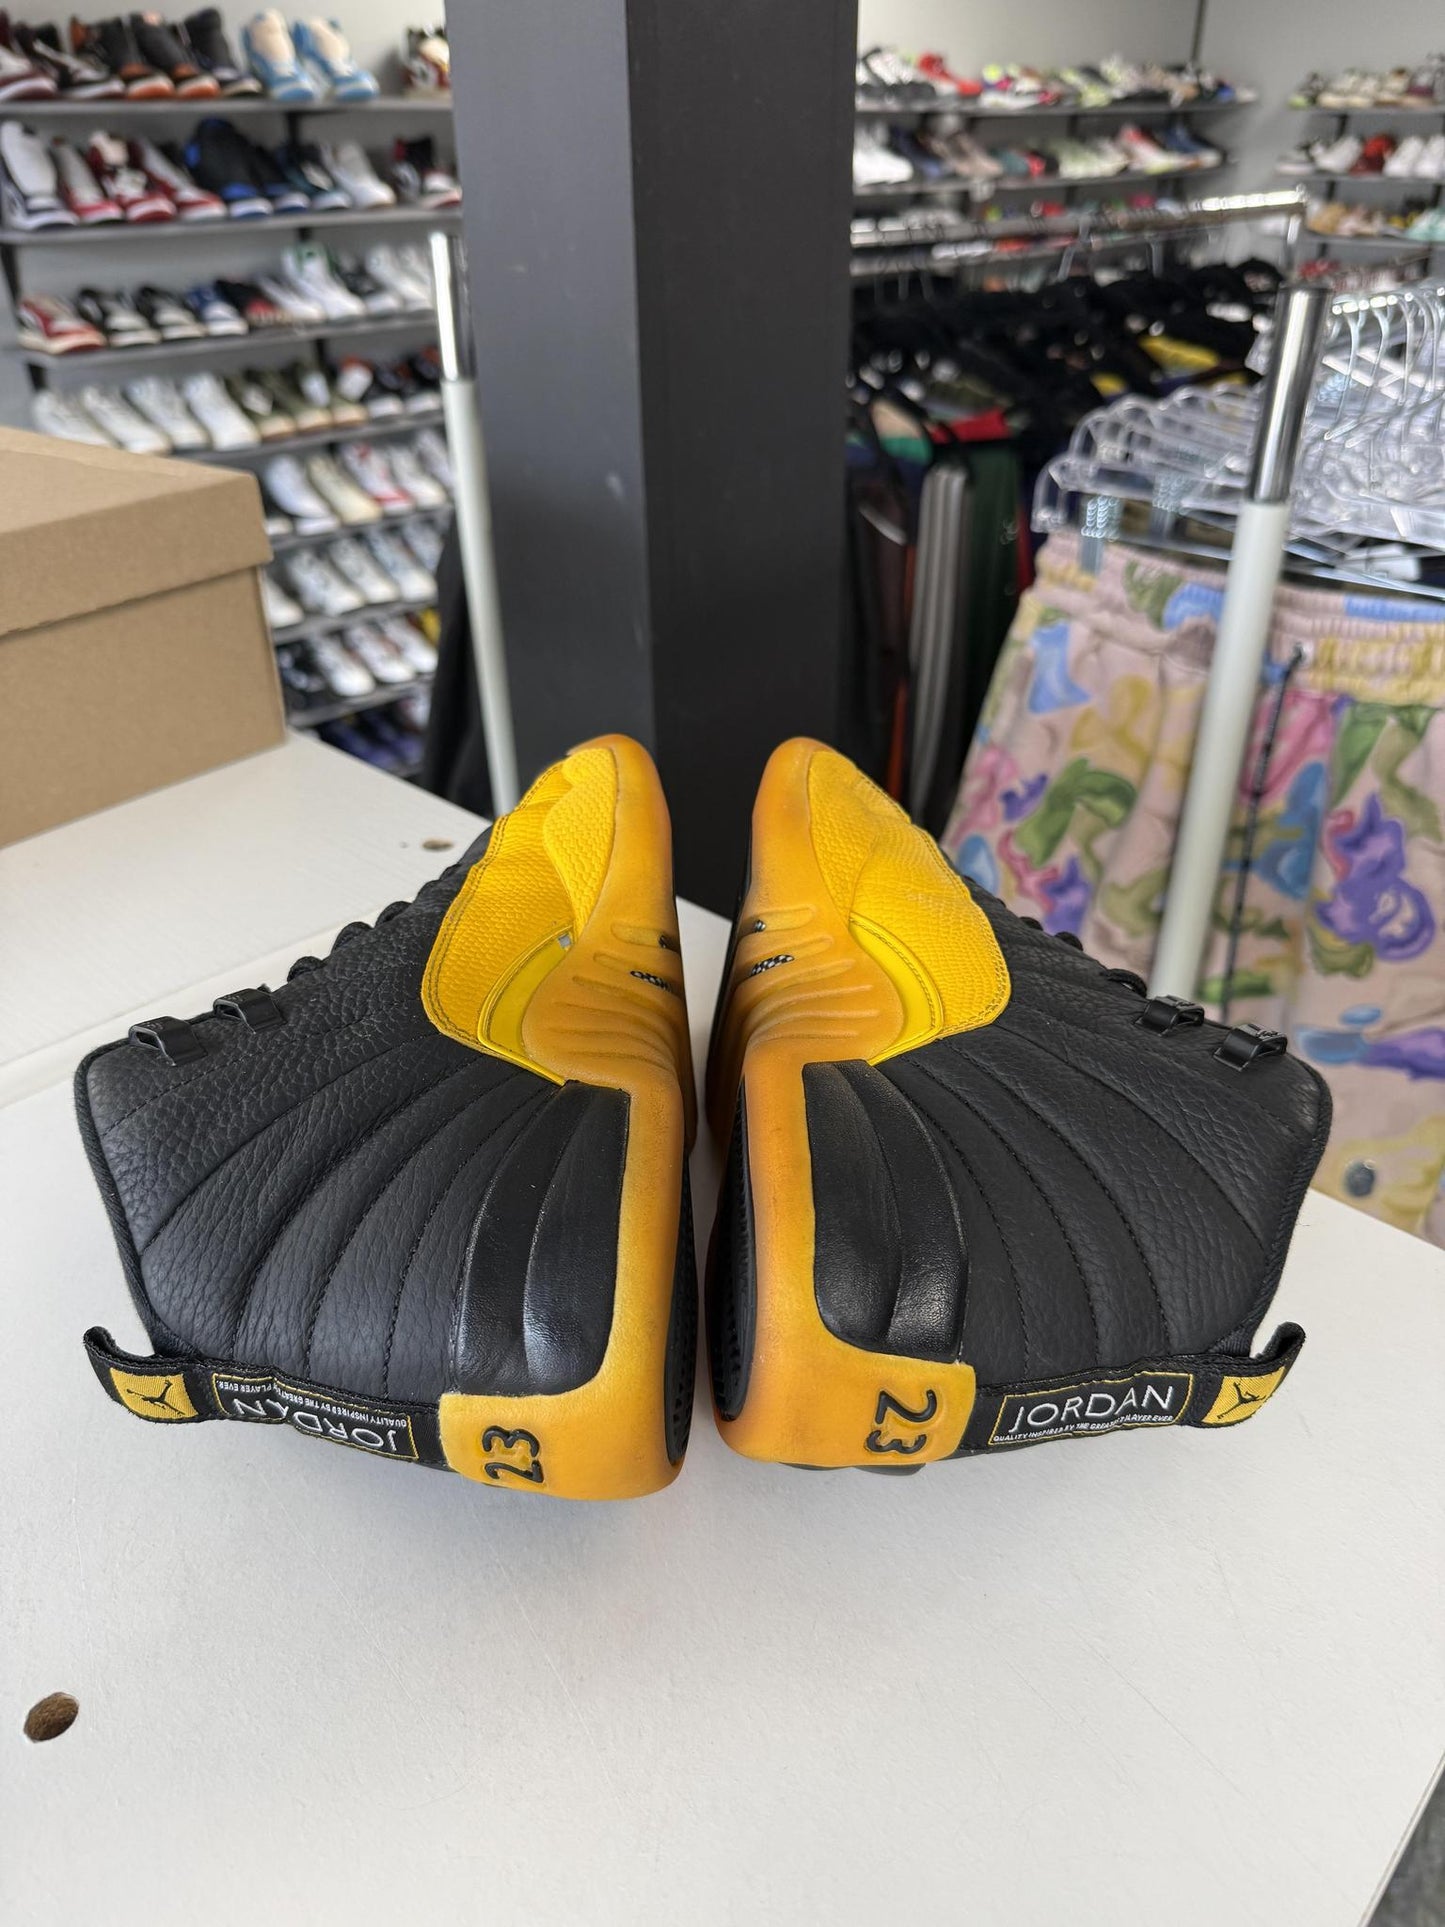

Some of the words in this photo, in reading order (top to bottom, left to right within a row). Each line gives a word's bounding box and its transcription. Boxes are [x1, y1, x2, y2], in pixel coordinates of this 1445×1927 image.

[239, 1383, 273, 1394] PLAYER
[304, 1397, 320, 1410] THE
[320, 1402, 332, 1412] BY
[1008, 1384, 1174, 1432] JORDAN
[331, 1406, 370, 1424] INSPIRED
[370, 1415, 408, 1428] QUALITY
[864, 1389, 937, 1454] 23
[233, 1398, 397, 1451] JORDAN
[993, 1431, 1027, 1442] QUALITY
[1026, 1425, 1064, 1438] INSPIRED
[481, 1424, 544, 1484] 23
